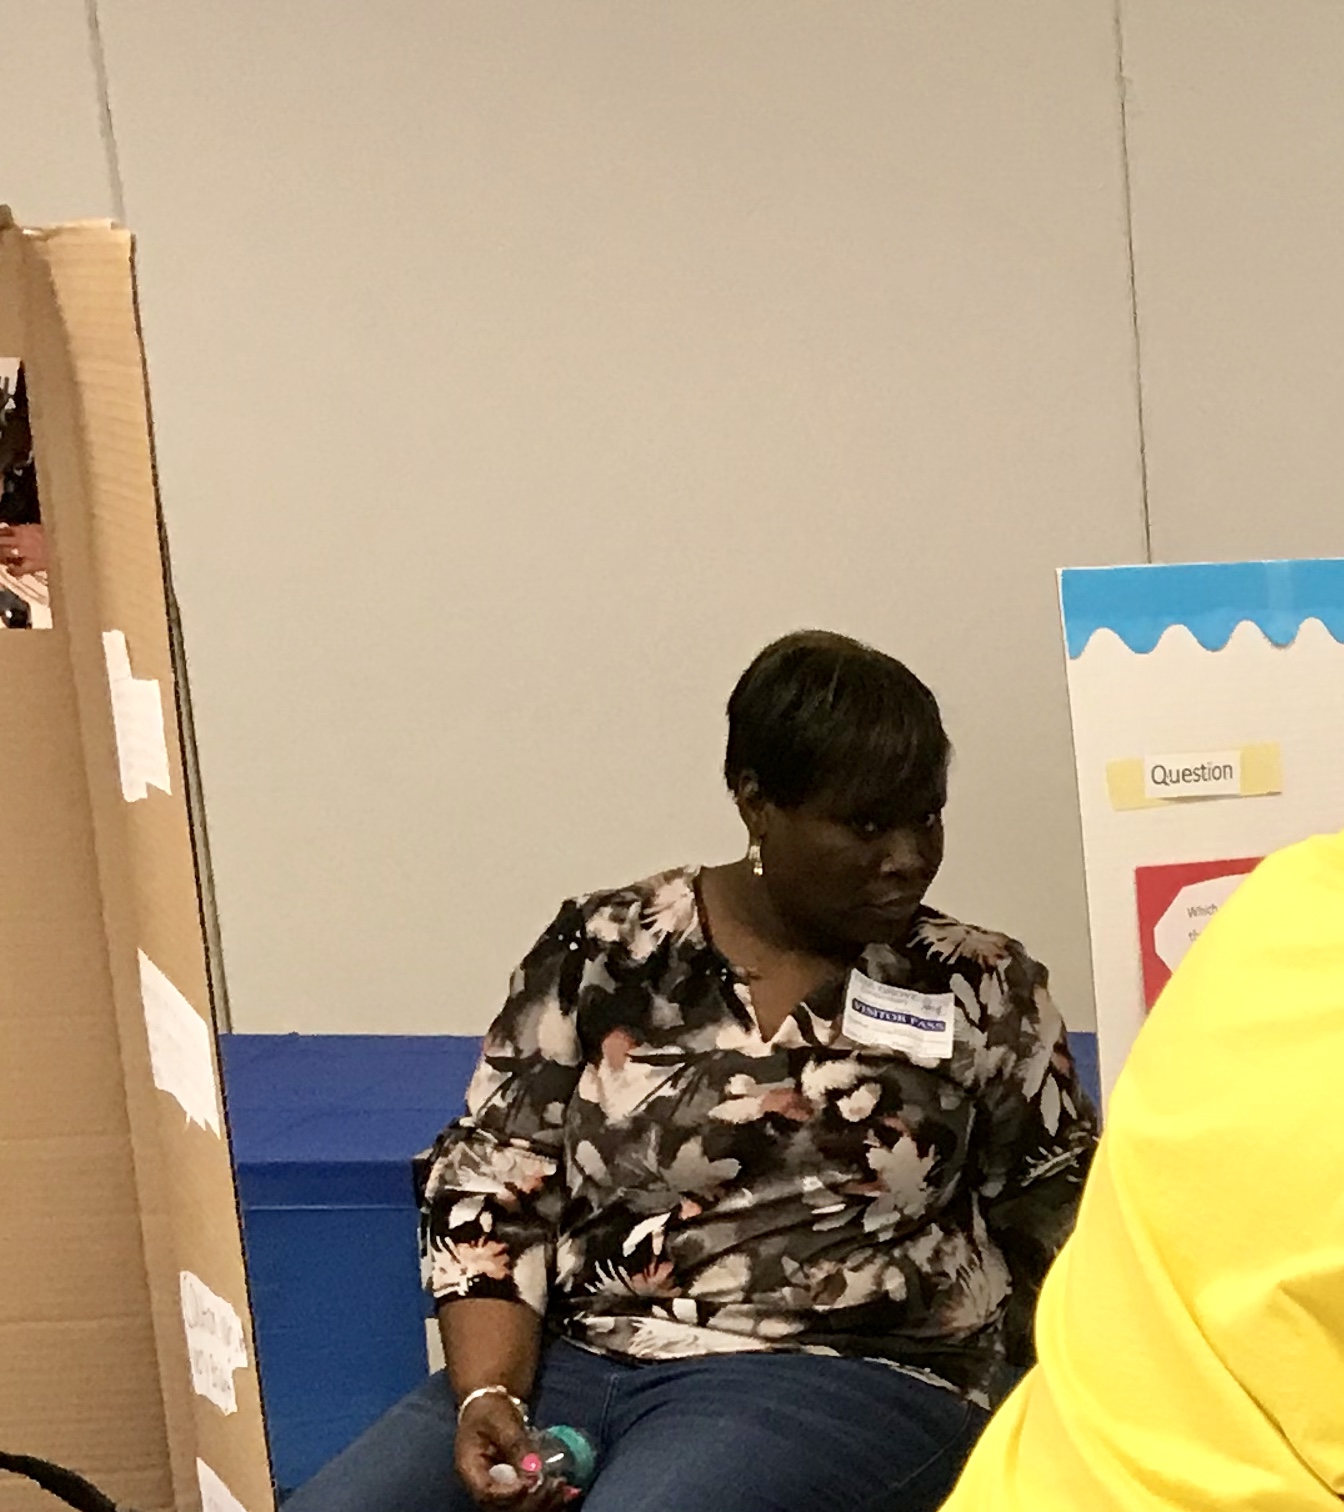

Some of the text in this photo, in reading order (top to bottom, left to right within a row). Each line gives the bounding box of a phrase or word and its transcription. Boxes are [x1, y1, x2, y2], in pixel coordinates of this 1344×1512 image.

[1151, 762, 1233, 786] Question
[854, 1001, 907, 1023] VISITOR
[910, 1014, 945, 1031] PASS
